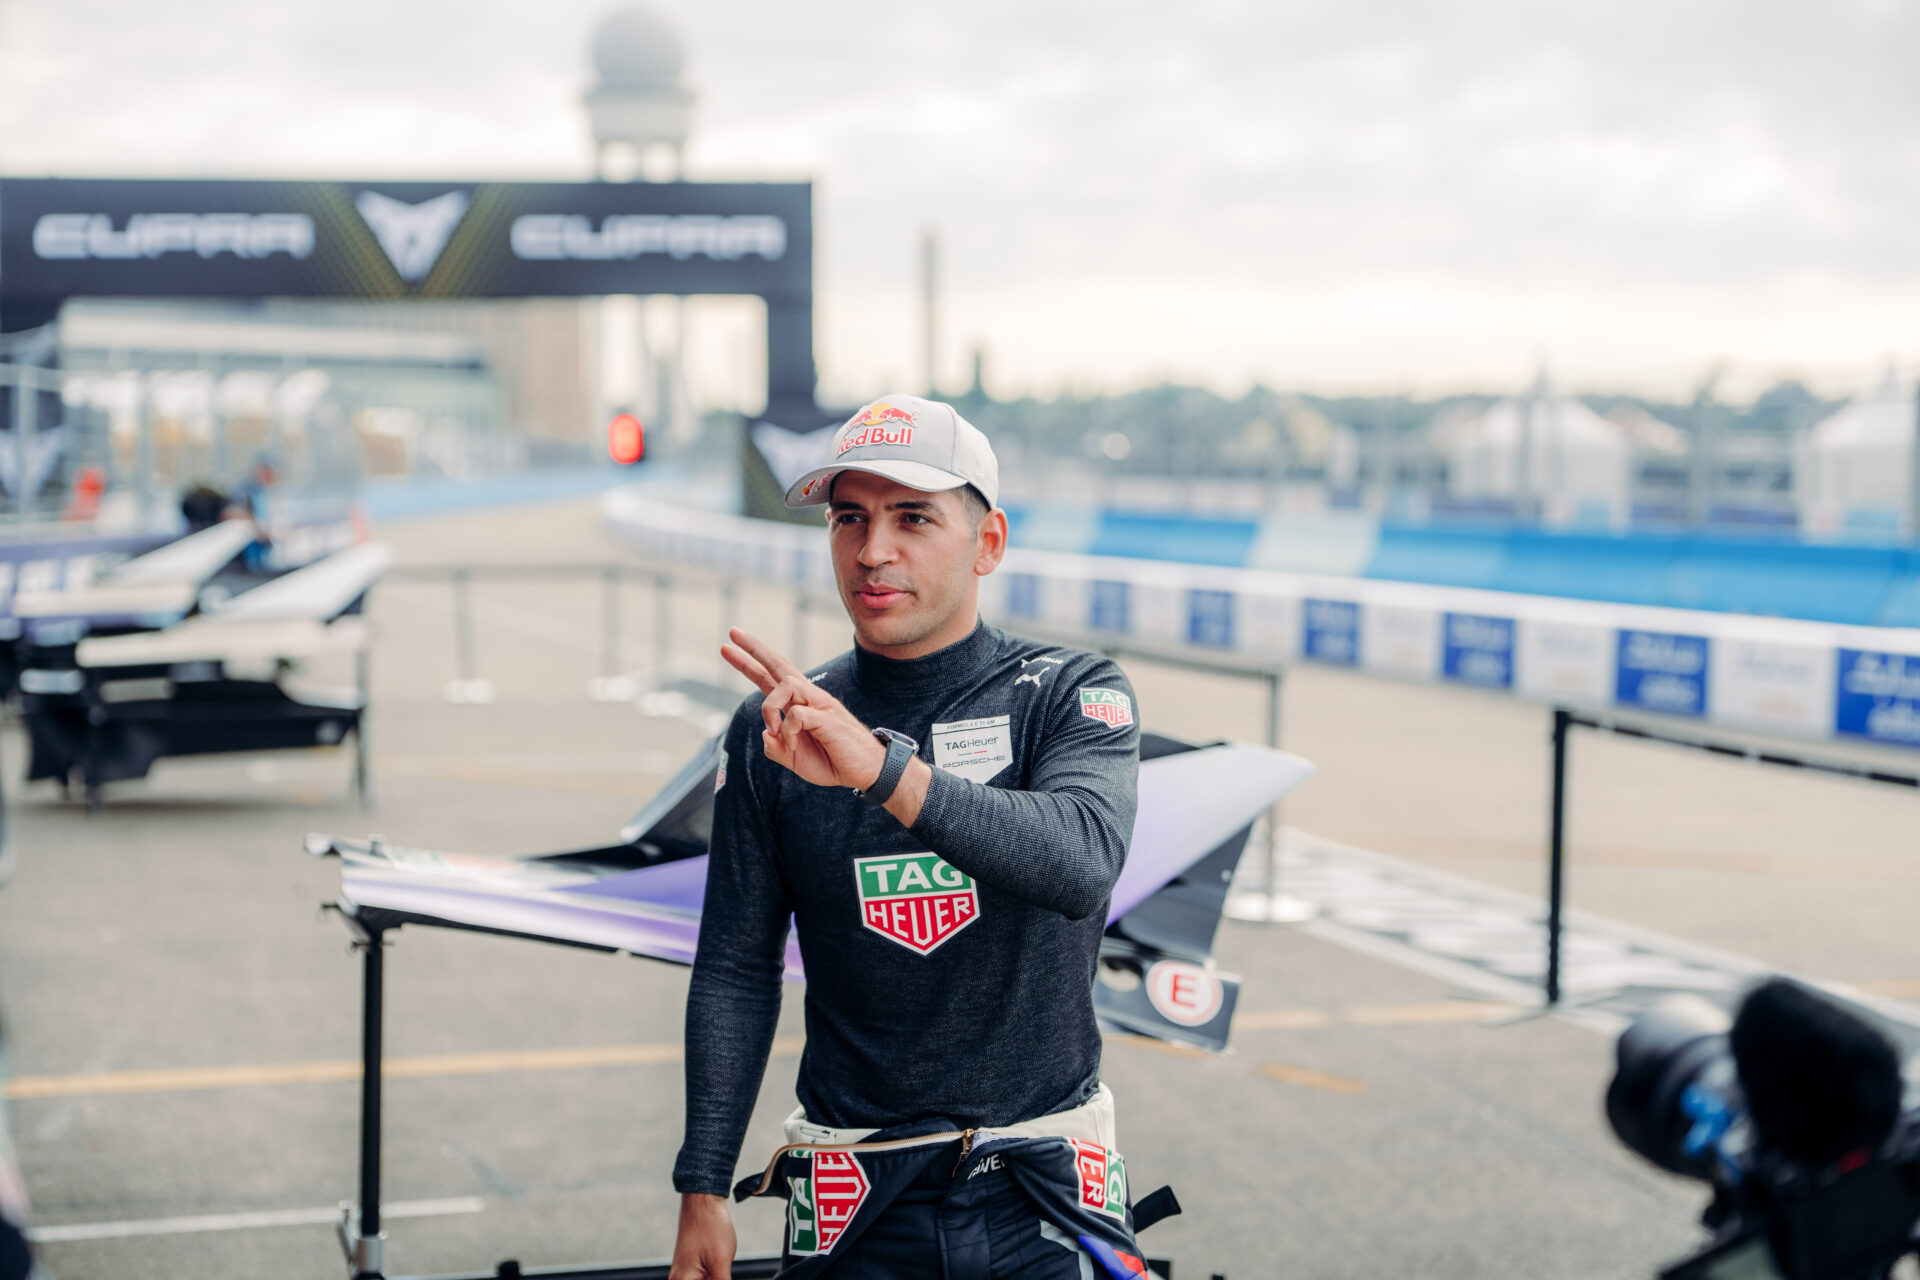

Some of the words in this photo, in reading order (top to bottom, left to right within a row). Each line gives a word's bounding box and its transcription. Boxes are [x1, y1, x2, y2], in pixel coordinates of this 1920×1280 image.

[836, 427, 869, 456] Red
[870, 427, 912, 445] Bull
[1084, 691, 1128, 708] TAG
[1086, 705, 1130, 724] HEUER
[943, 755, 1006, 769] PORSCHE
[865, 859, 964, 893] TAG
[869, 896, 971, 946] HEUER
[1172, 973, 1197, 1008] E
[789, 1151, 813, 1243] TA
[817, 1153, 863, 1247] HEUE
